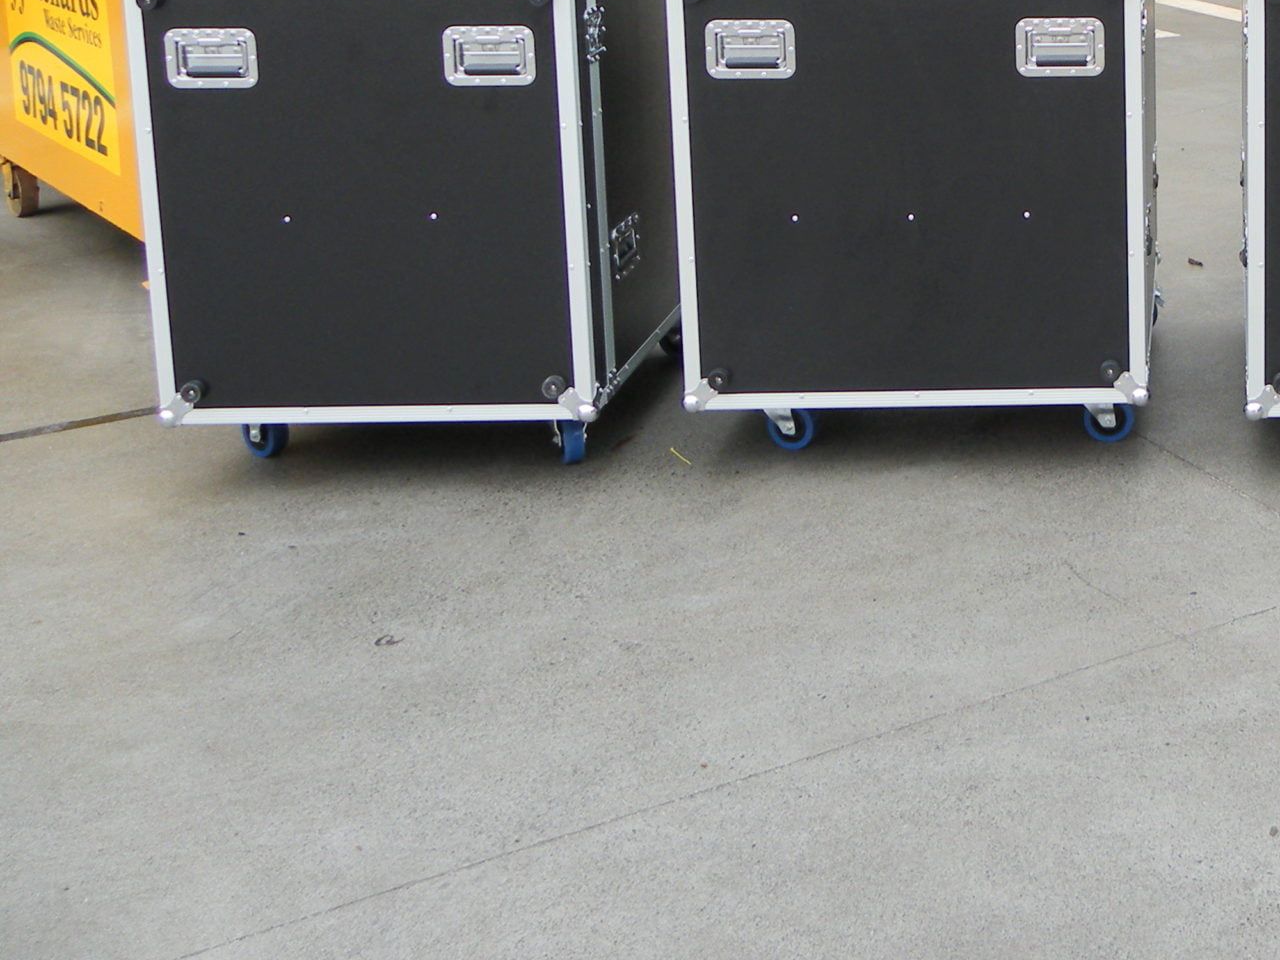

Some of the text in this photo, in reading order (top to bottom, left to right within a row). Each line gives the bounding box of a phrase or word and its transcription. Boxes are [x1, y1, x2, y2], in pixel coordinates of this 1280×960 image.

[43, 7, 66, 36] Waste
[19, 59, 109, 157] 9794 5722
